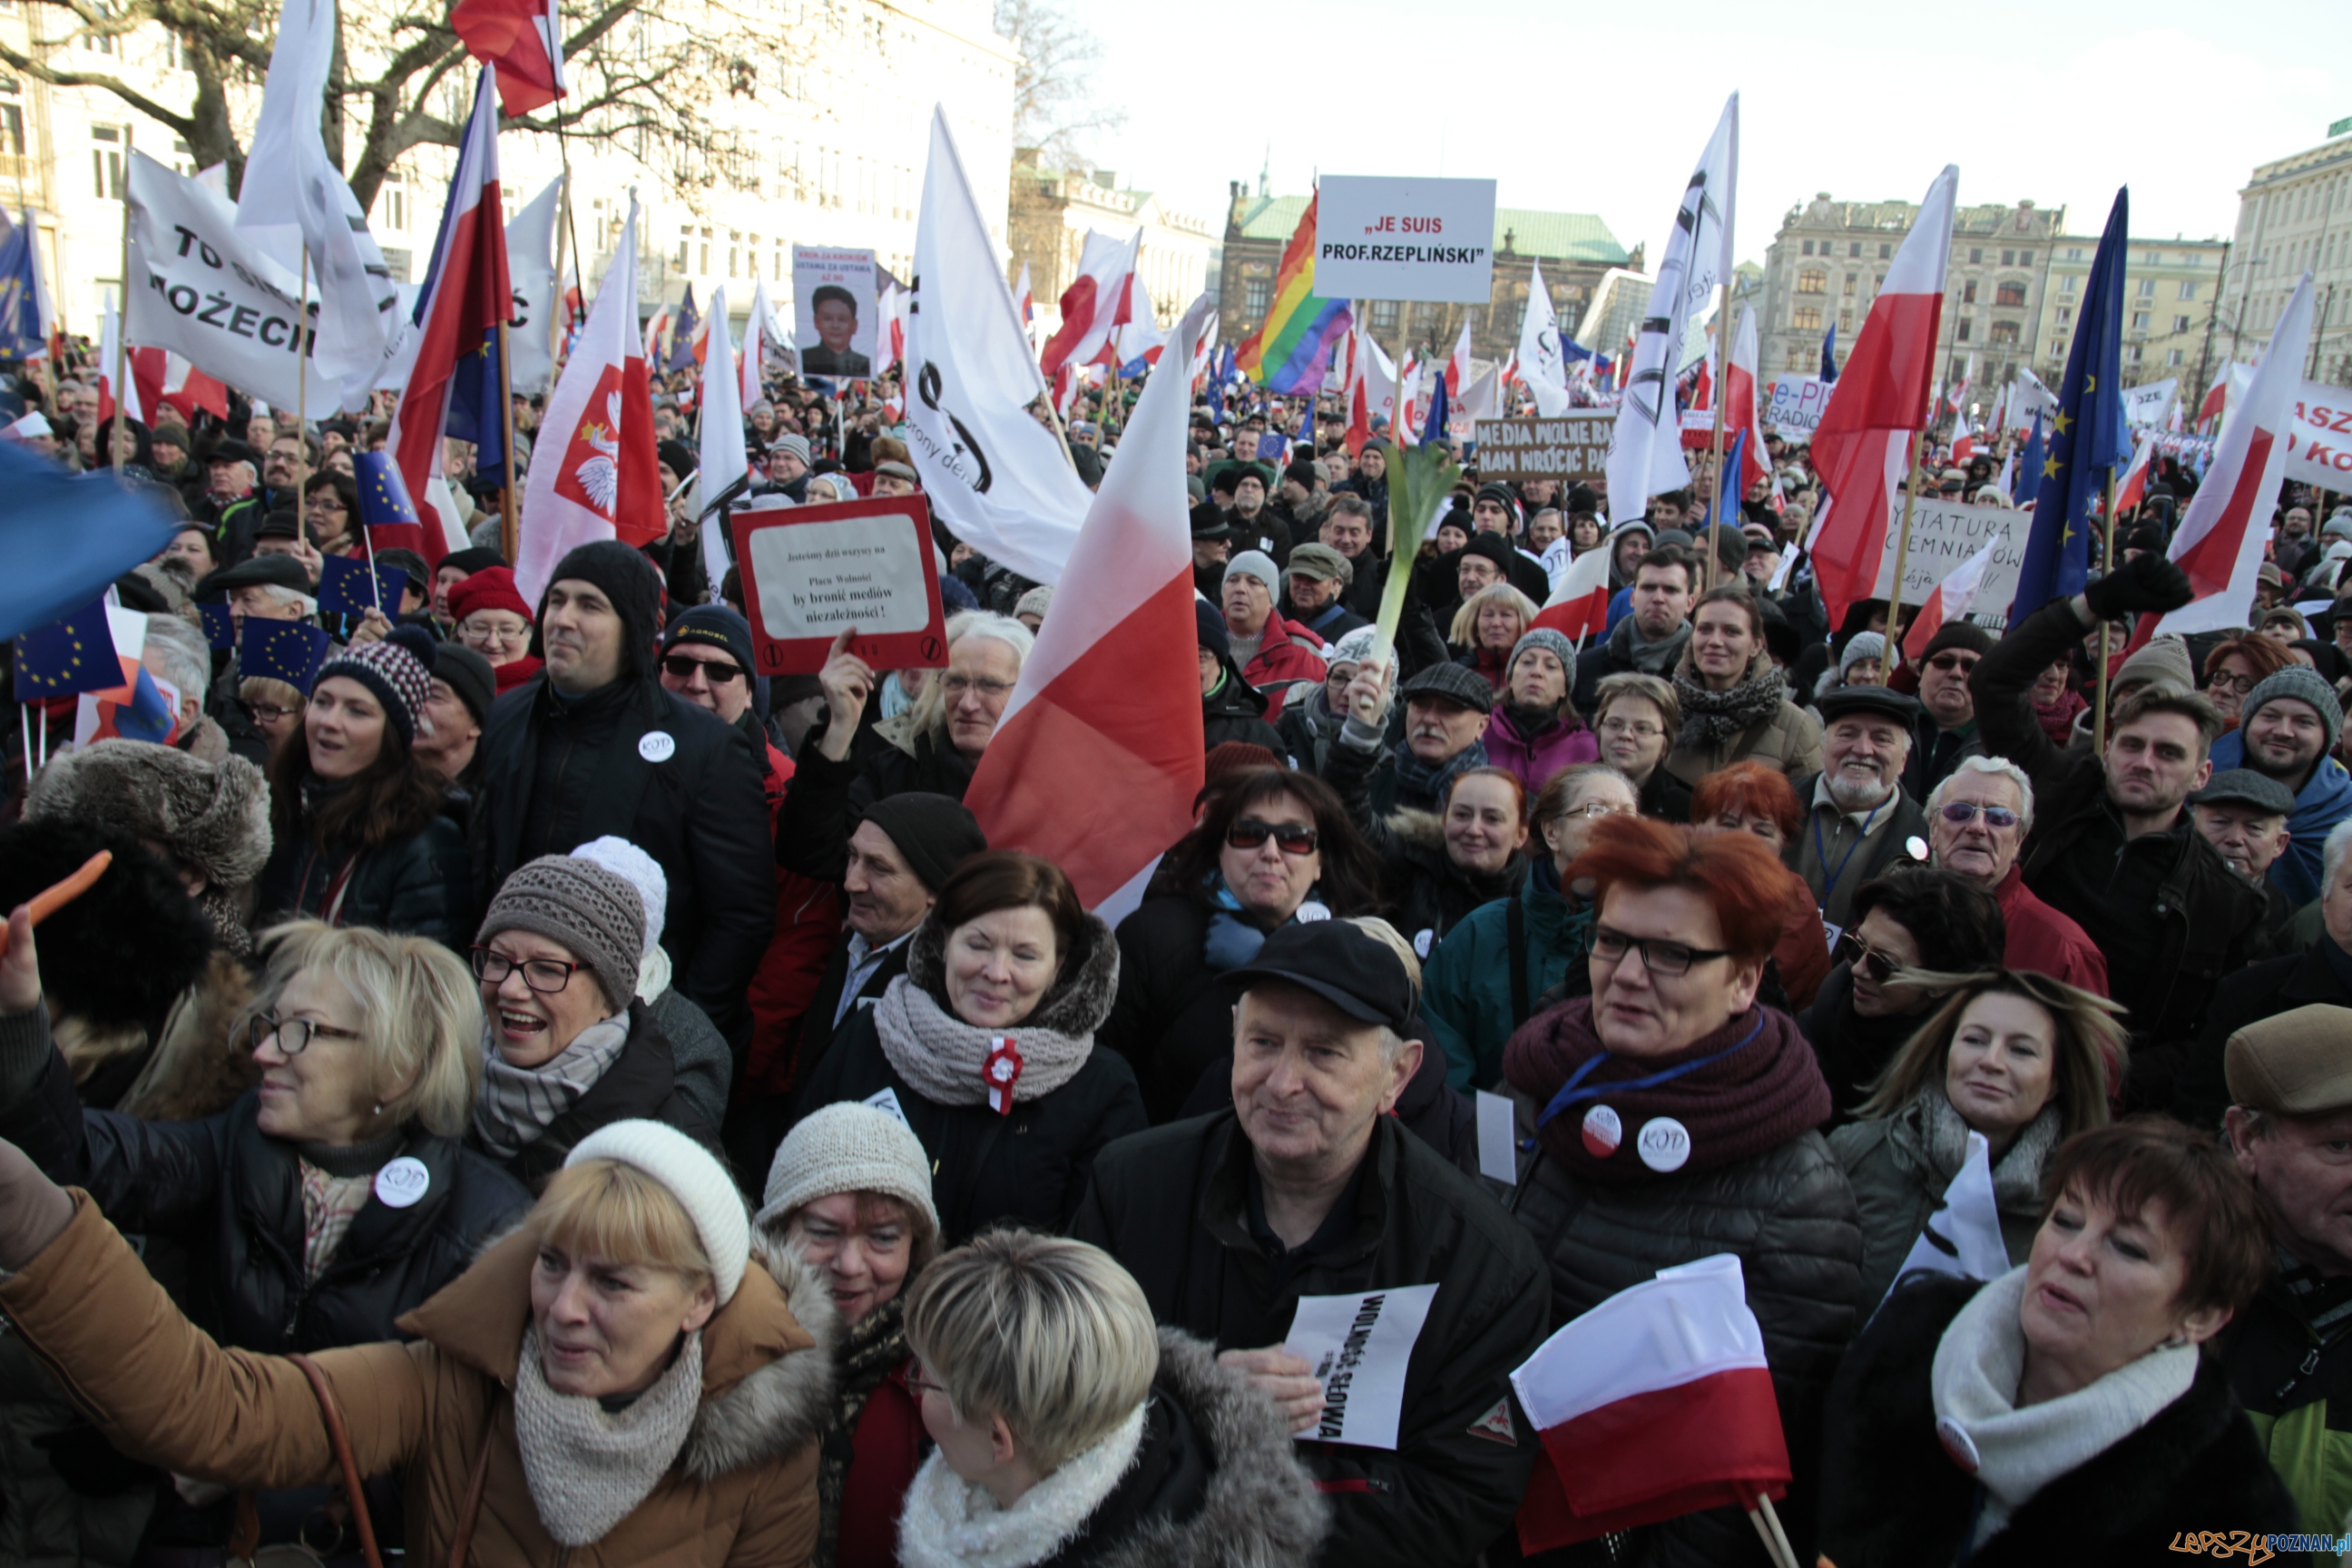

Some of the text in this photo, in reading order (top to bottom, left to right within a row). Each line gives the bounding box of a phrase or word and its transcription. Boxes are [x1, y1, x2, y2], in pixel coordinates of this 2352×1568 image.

[1402, 217, 1442, 233] SUIS
[173, 223, 223, 270] TO
[1322, 242, 1485, 264] PROF.RZEPLIŃSKI”
[1476, 423, 1533, 447] MEDIA
[1480, 450, 1516, 474] NAM
[1520, 445, 1582, 474] WRÓCIĆ
[788, 545, 885, 562] Jesteśmy dziś wszyscy na
[808, 573, 872, 587] Placu Wolności
[793, 586, 892, 608] by bronić mediów
[806, 605, 878, 623] niezależności
[691, 628, 729, 642] AGROBEL
[1642, 1129, 1685, 1152] KOD
[1336, 1294, 1386, 1370] WOLNOŚĆ
[1318, 1371, 1353, 1439] SŁOWA
